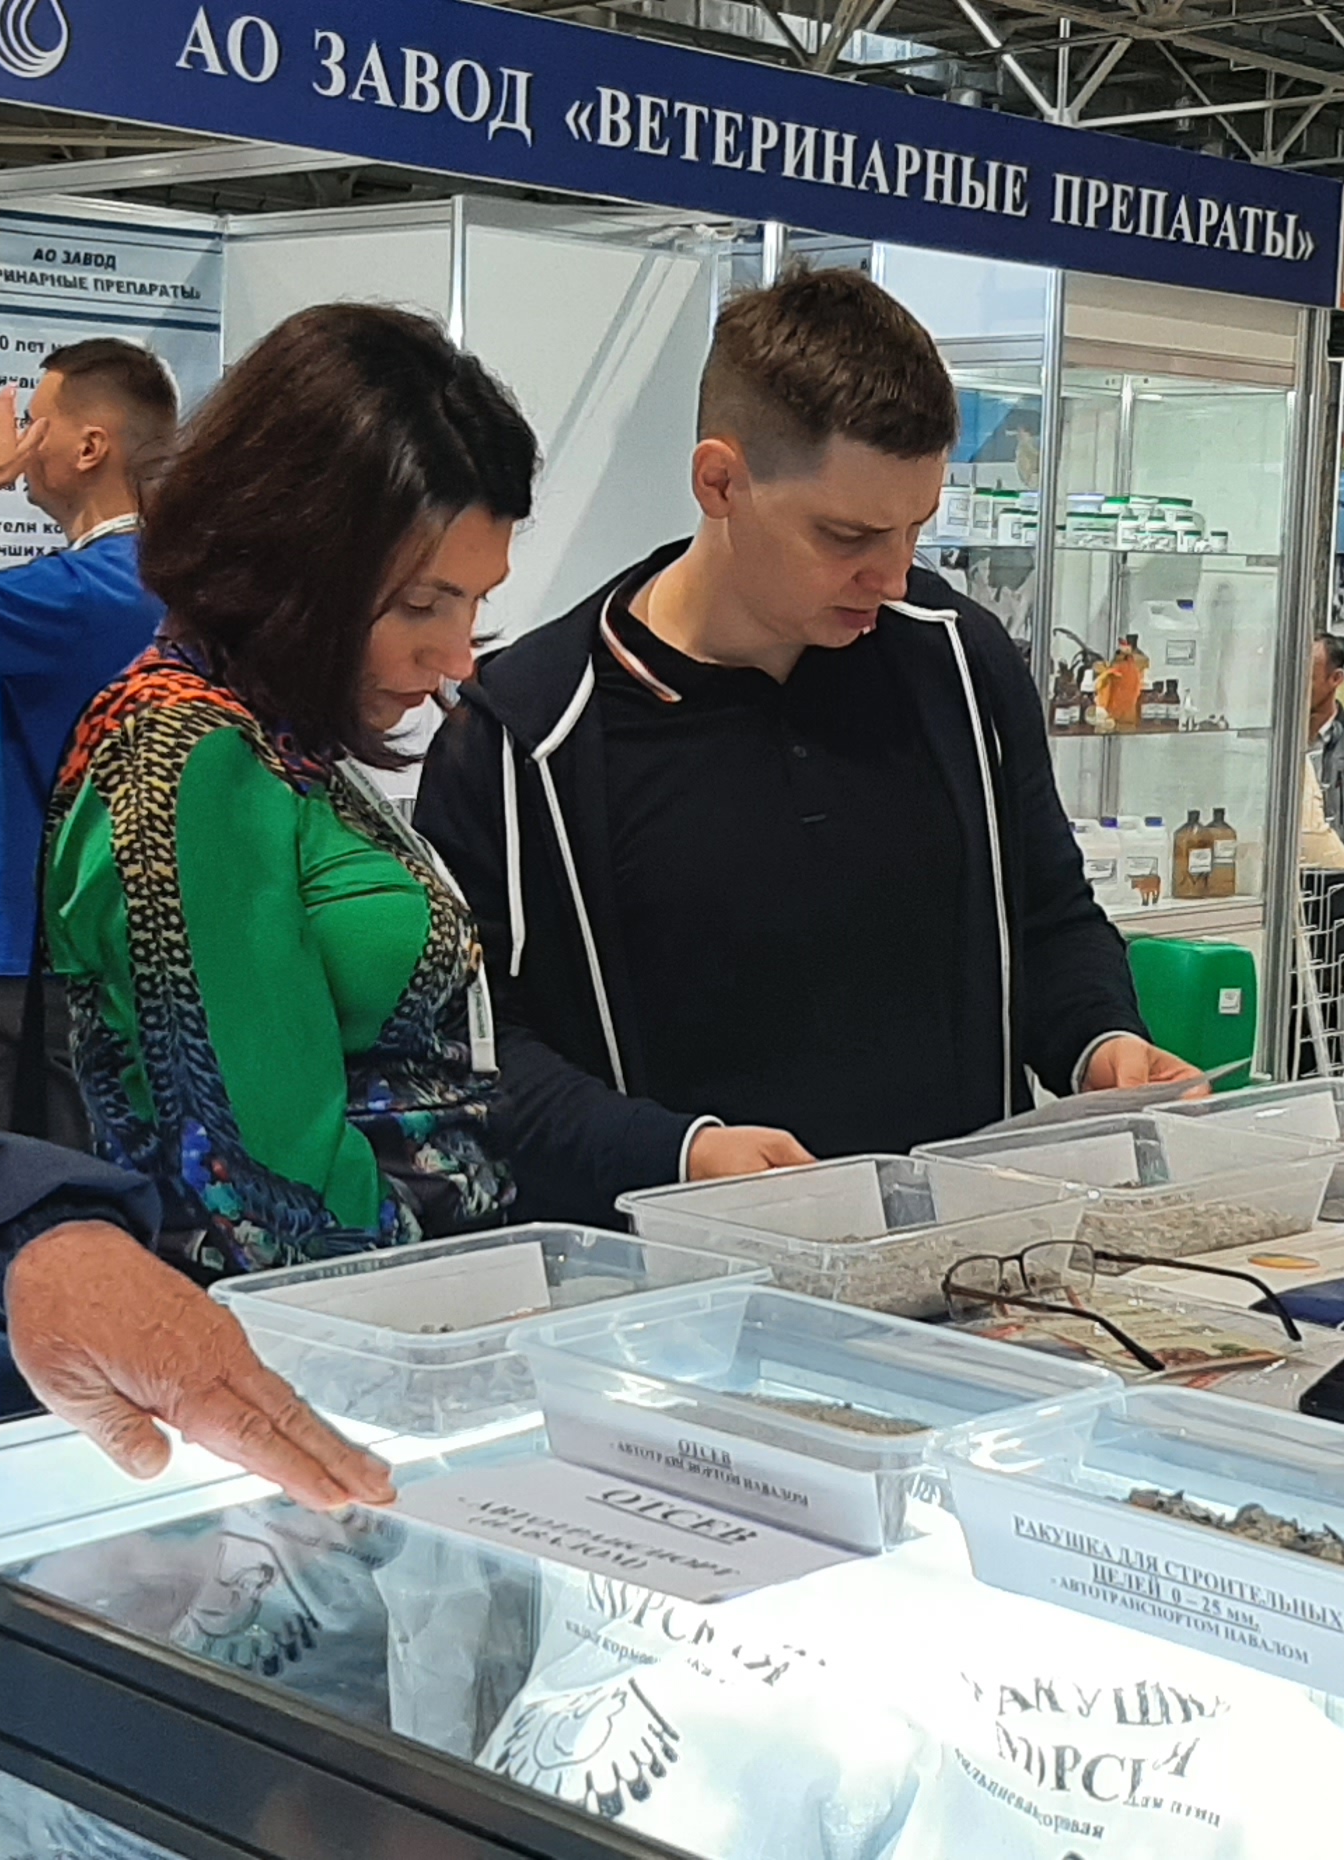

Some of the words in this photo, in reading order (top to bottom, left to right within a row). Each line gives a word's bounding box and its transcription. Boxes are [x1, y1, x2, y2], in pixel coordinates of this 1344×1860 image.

[176, 5, 280, 84] АО
[312, 28, 534, 148] ЗАВОД
[565, 86, 1029, 219] «ВЕТЕРИНАРНЫЕ
[1051, 172, 1316, 264] ПРЕПАРАТЫ»
[33, 248, 56, 262] АО
[62, 250, 117, 271] ЗАВОД
[16, 341, 45, 353] лет
[601, 1488, 758, 1543] ОТСЕВ
[1013, 1514, 1113, 1561] РАКУШКА
[1117, 1545, 1159, 1574] ДЛЯ
[1164, 1560, 1344, 1630] СТРОИТЕЛЬНЫХ
[1092, 1562, 1161, 1600] ЦЕЛЕЙ
[1171, 1588, 1182, 1605] 0
[1202, 1597, 1223, 1616] 25
[1059, 1576, 1220, 1638] АВТОТРАНСПОРТОМ
[1224, 1625, 1309, 1664] НАВАЛОМ
